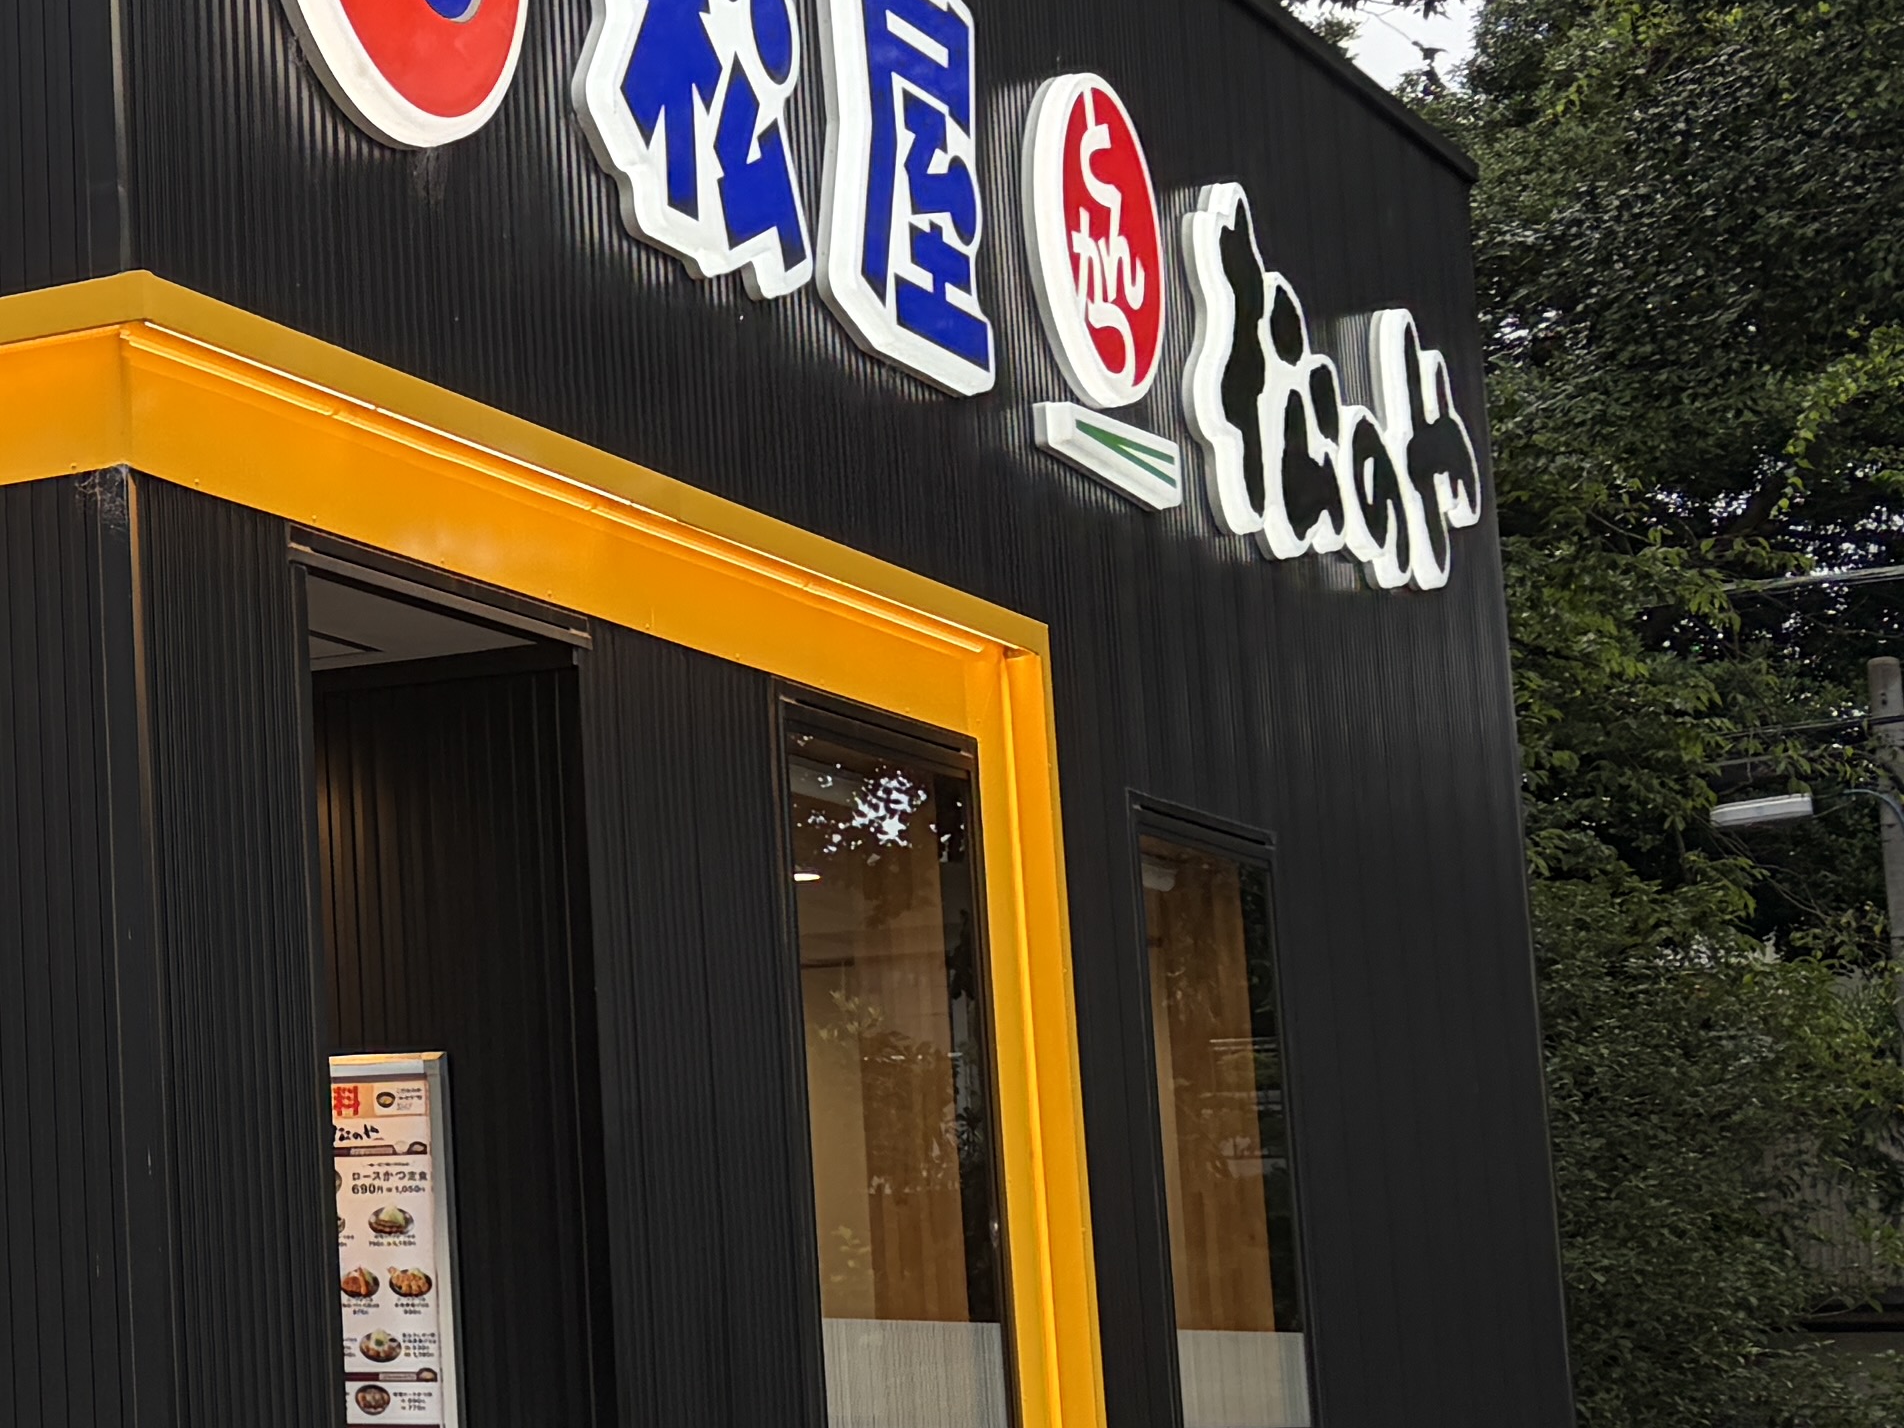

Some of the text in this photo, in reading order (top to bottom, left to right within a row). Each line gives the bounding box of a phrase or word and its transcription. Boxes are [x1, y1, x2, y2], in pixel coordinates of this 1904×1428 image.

[1070, 90, 1148, 380] とんかつ
[1217, 205, 1476, 584] 松のや
